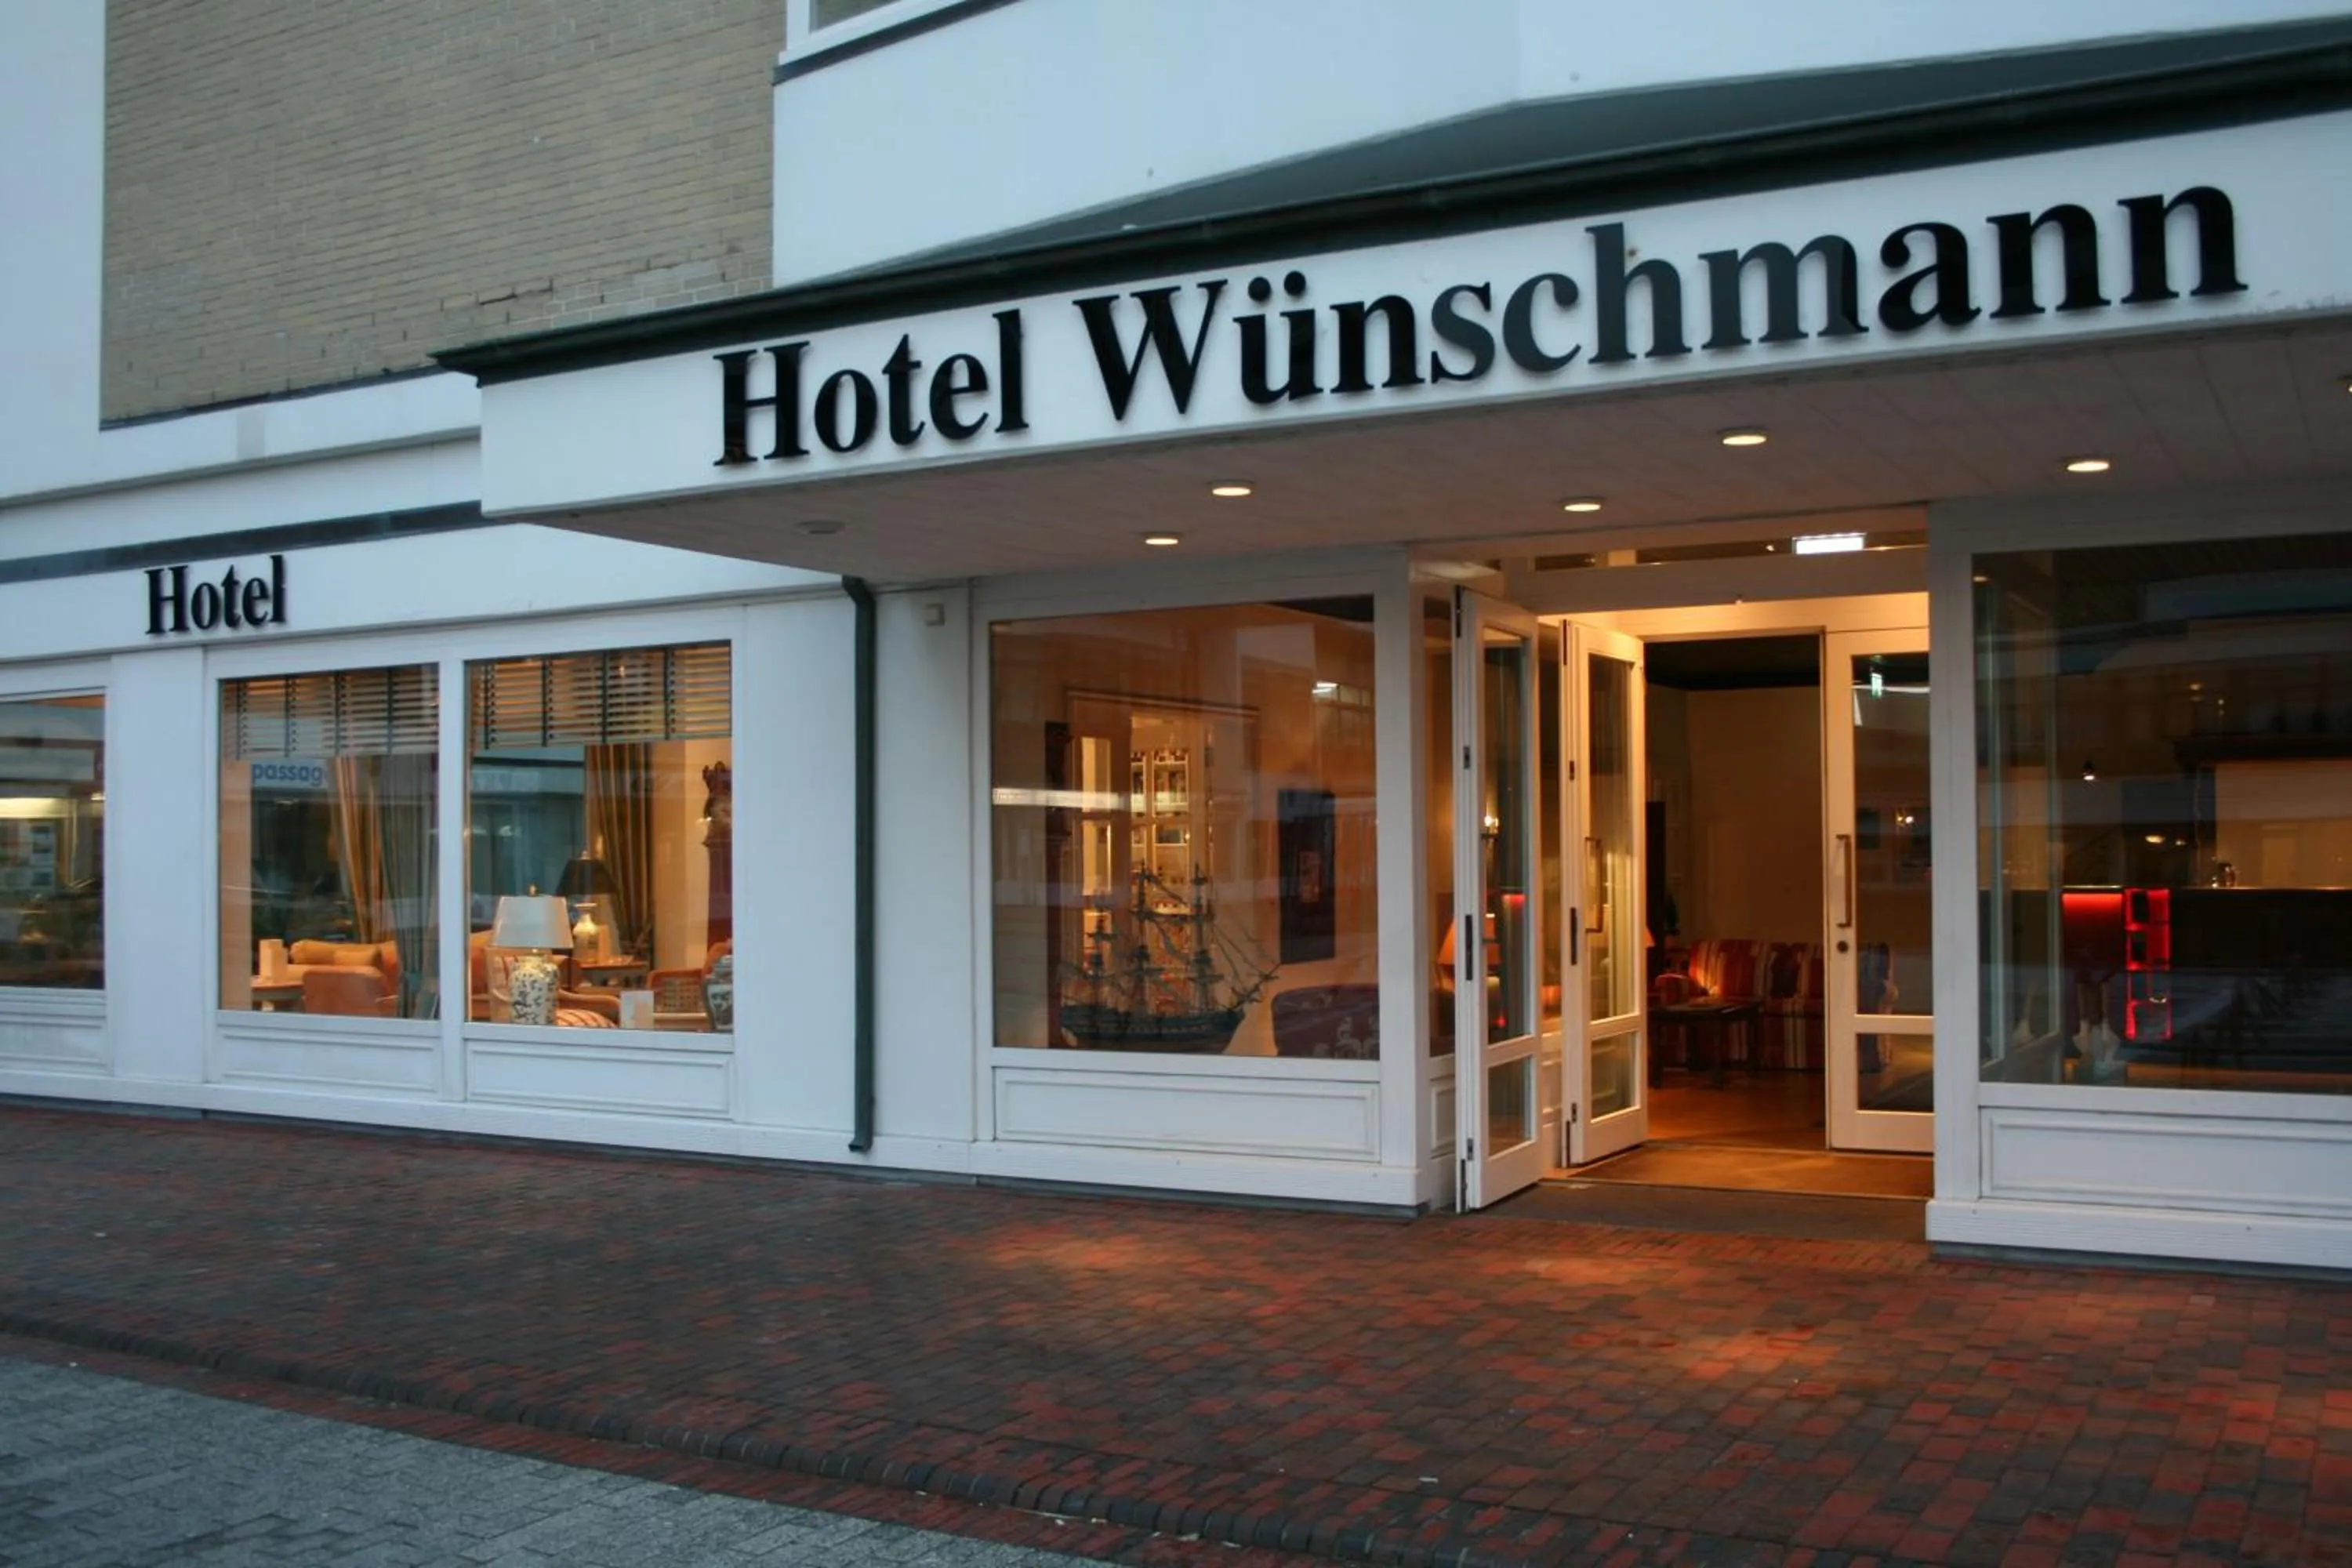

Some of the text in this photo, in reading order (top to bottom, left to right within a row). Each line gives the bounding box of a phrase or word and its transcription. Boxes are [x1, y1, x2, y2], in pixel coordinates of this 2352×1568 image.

[713, 185, 2249, 467] Hotel Wünschmann
[144, 554, 287, 636] Hotel
